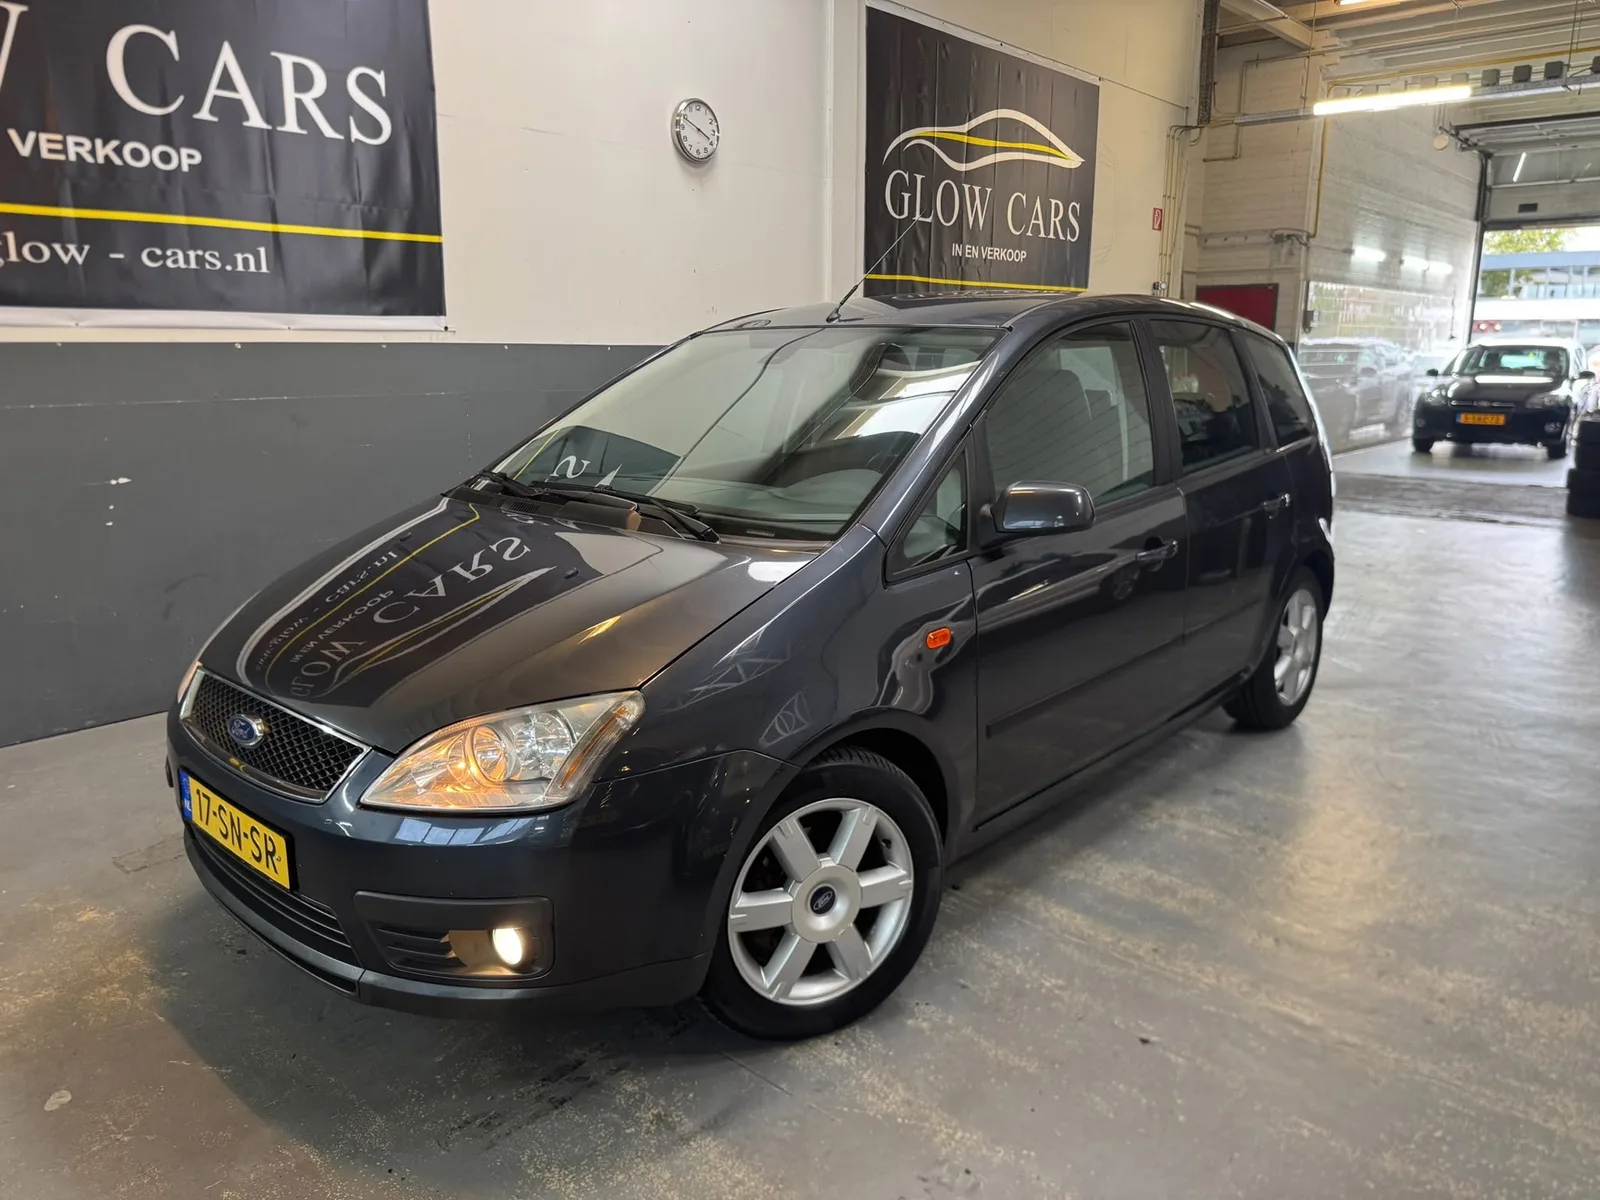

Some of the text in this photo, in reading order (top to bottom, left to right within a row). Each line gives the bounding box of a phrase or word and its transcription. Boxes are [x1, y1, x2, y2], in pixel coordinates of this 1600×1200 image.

[106, 24, 392, 146] CARS
[7, 128, 202, 173] VERKOOP
[884, 169, 1081, 242] GLOW CARS
[0, 231, 91, 268] low
[141, 246, 270, 273] cars.nl
[952, 243, 1027, 262] IN EN VERKOOP
[196, 788, 279, 875] 17-SN-SR
